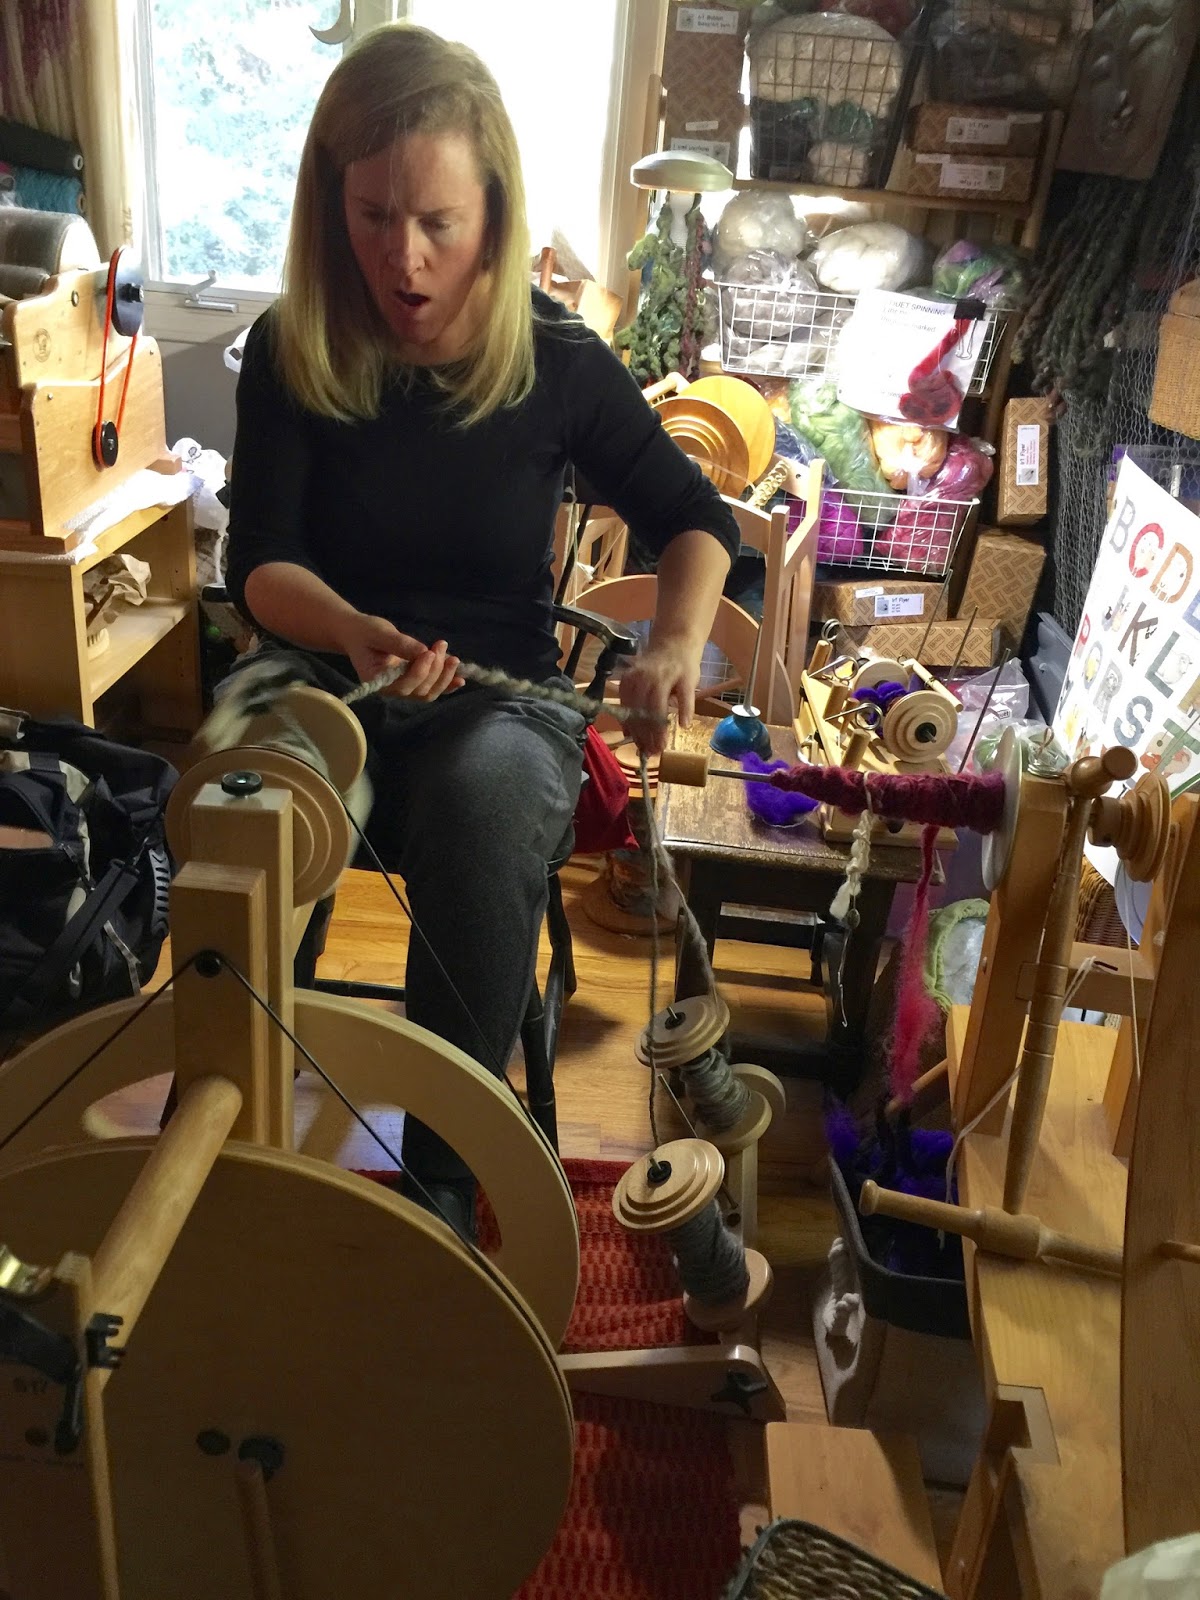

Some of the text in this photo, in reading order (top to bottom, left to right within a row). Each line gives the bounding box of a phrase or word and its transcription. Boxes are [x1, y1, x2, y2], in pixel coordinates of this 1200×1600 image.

[911, 303, 946, 316] SPINNING
[1109, 496, 1193, 603] B C D
[1118, 602, 1158, 666] K
[1145, 631, 1180, 699] L
[1114, 695, 1153, 748] S
